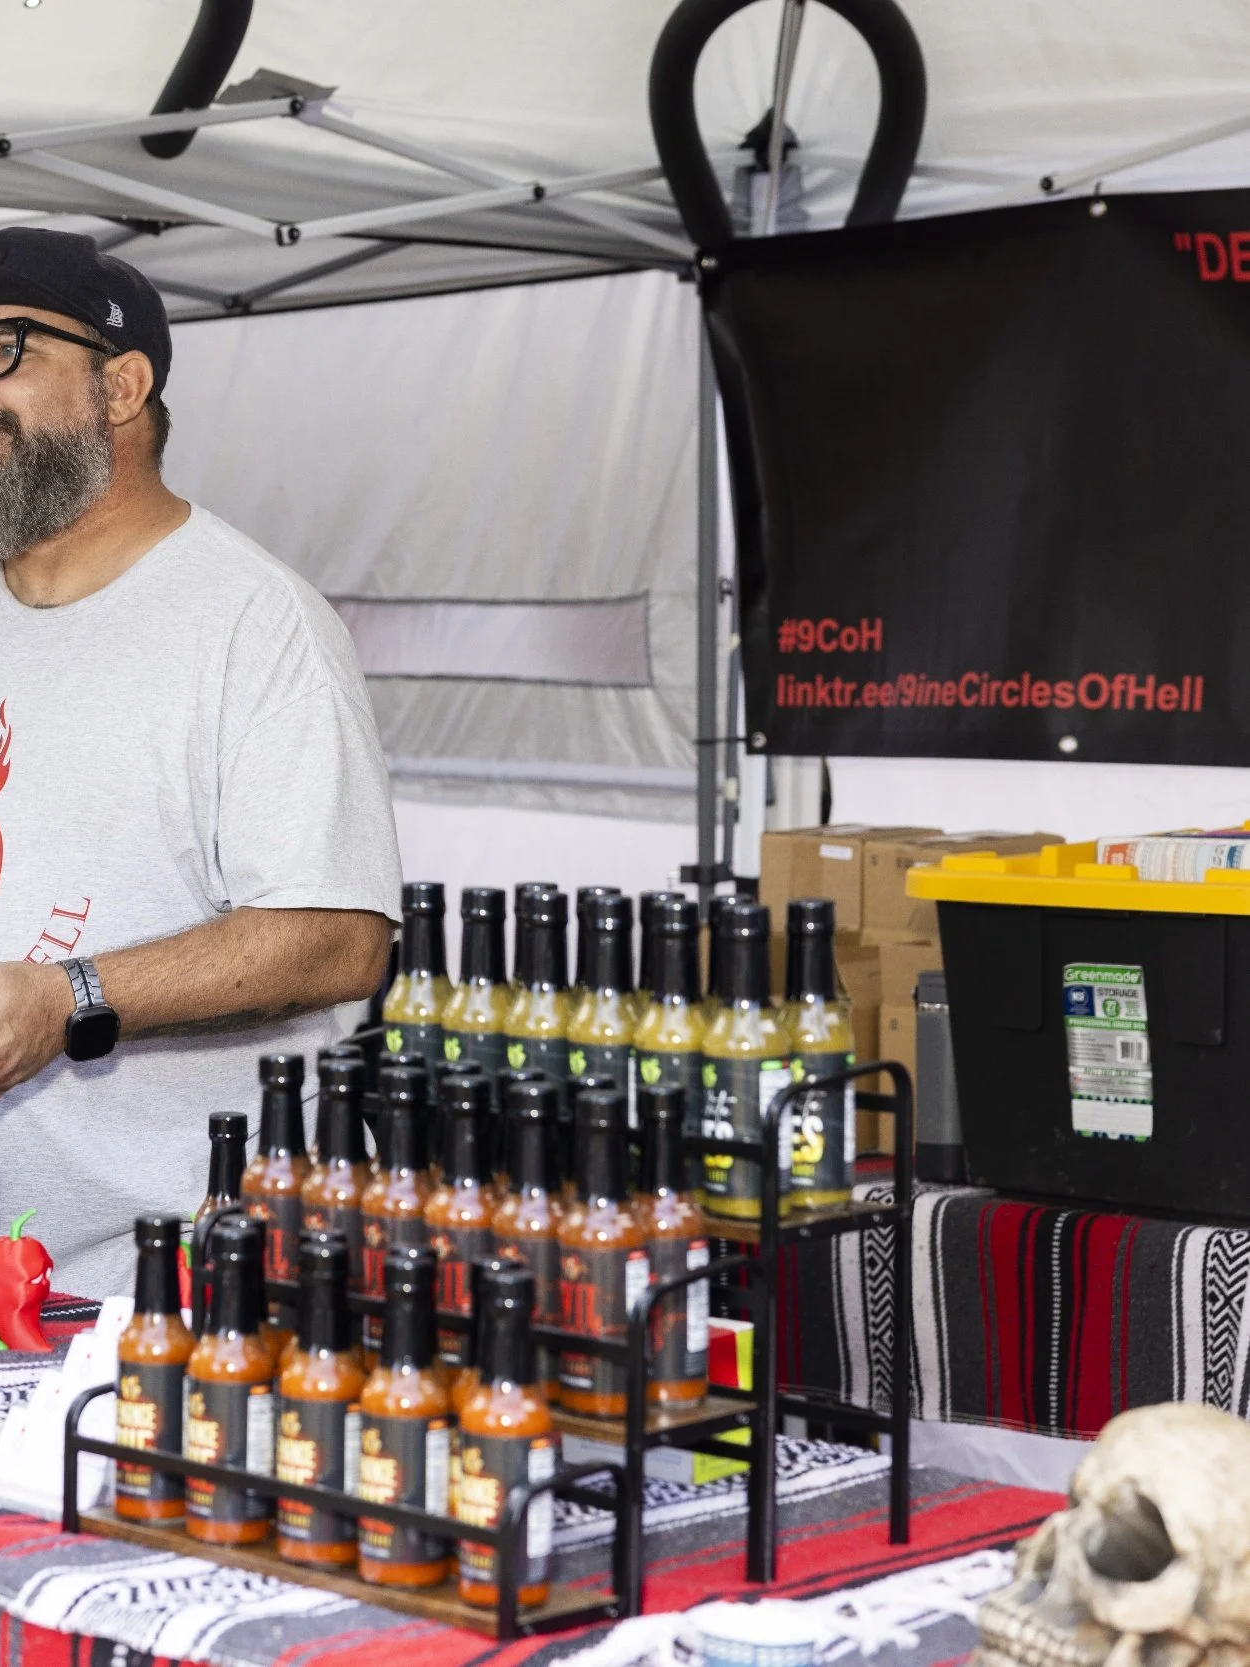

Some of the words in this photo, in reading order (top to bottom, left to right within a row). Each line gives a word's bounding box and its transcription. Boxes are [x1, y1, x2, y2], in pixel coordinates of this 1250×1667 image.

[777, 618, 883, 653] #9CoH
[777, 672, 1204, 711] linktr.ee/9ineCirclesOfHell
[21, 896, 91, 965] ELL
[1064, 968, 1140, 983] Greenmade
[1097, 988, 1137, 998] STORAGE
